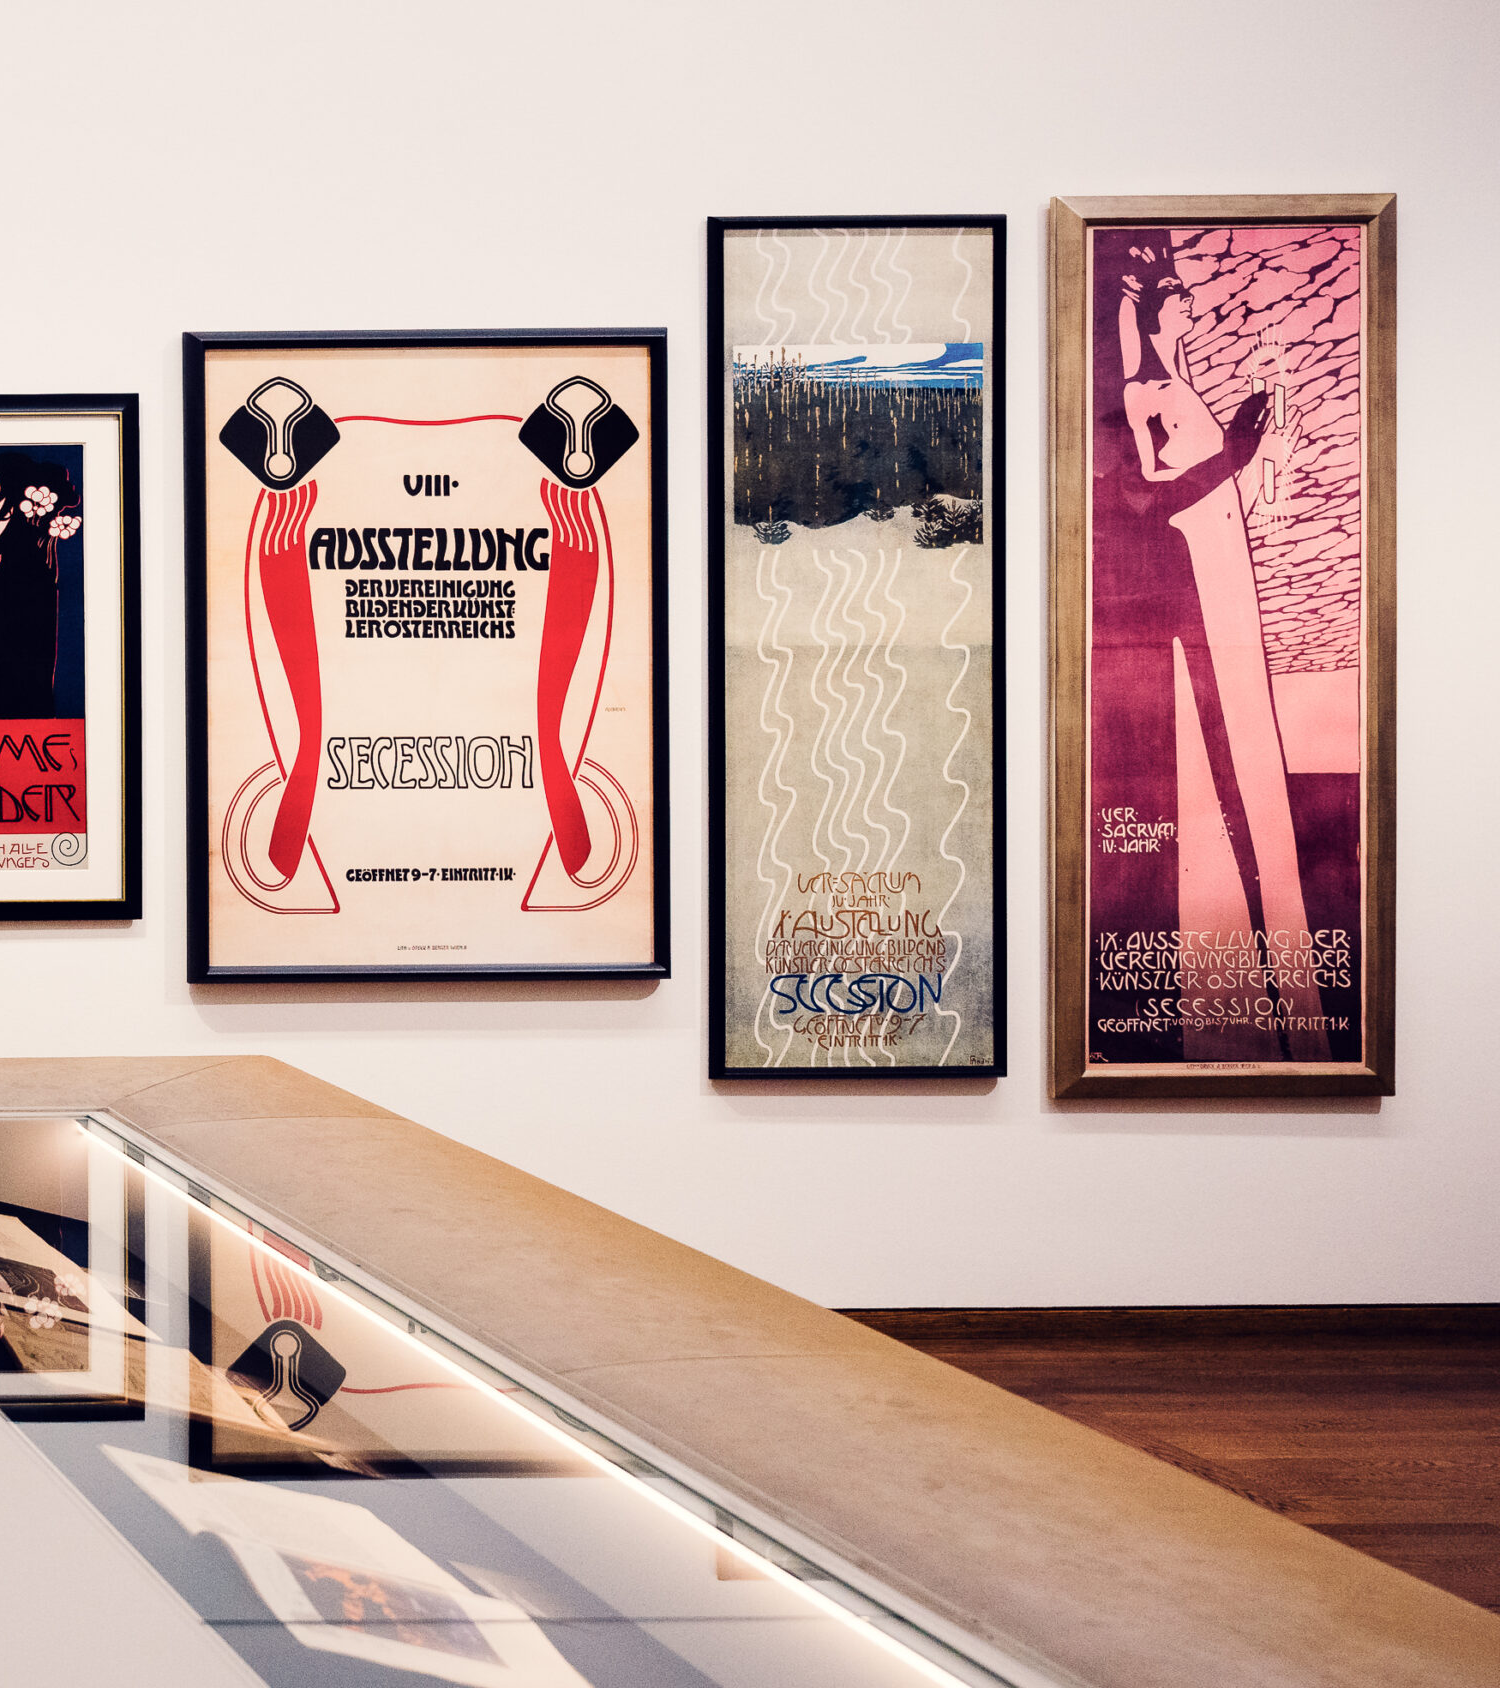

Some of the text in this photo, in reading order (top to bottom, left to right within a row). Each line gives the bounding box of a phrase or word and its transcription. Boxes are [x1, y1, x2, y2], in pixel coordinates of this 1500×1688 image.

[308, 527, 551, 572] AUSSTELLUNG
[345, 579, 516, 598] DER VEREINIGUNG
[345, 599, 452, 618] BILDENDER
[345, 619, 516, 639] LER ÖSTERREICHS
[327, 735, 534, 790] SECESSION
[9, 843, 48, 855] ALLE
[345, 868, 410, 882] GEÖFFNET
[769, 973, 943, 1014] SECESSION
[1143, 997, 1294, 1017] SECESSION
[1206, 1017, 1222, 1026] BIS
